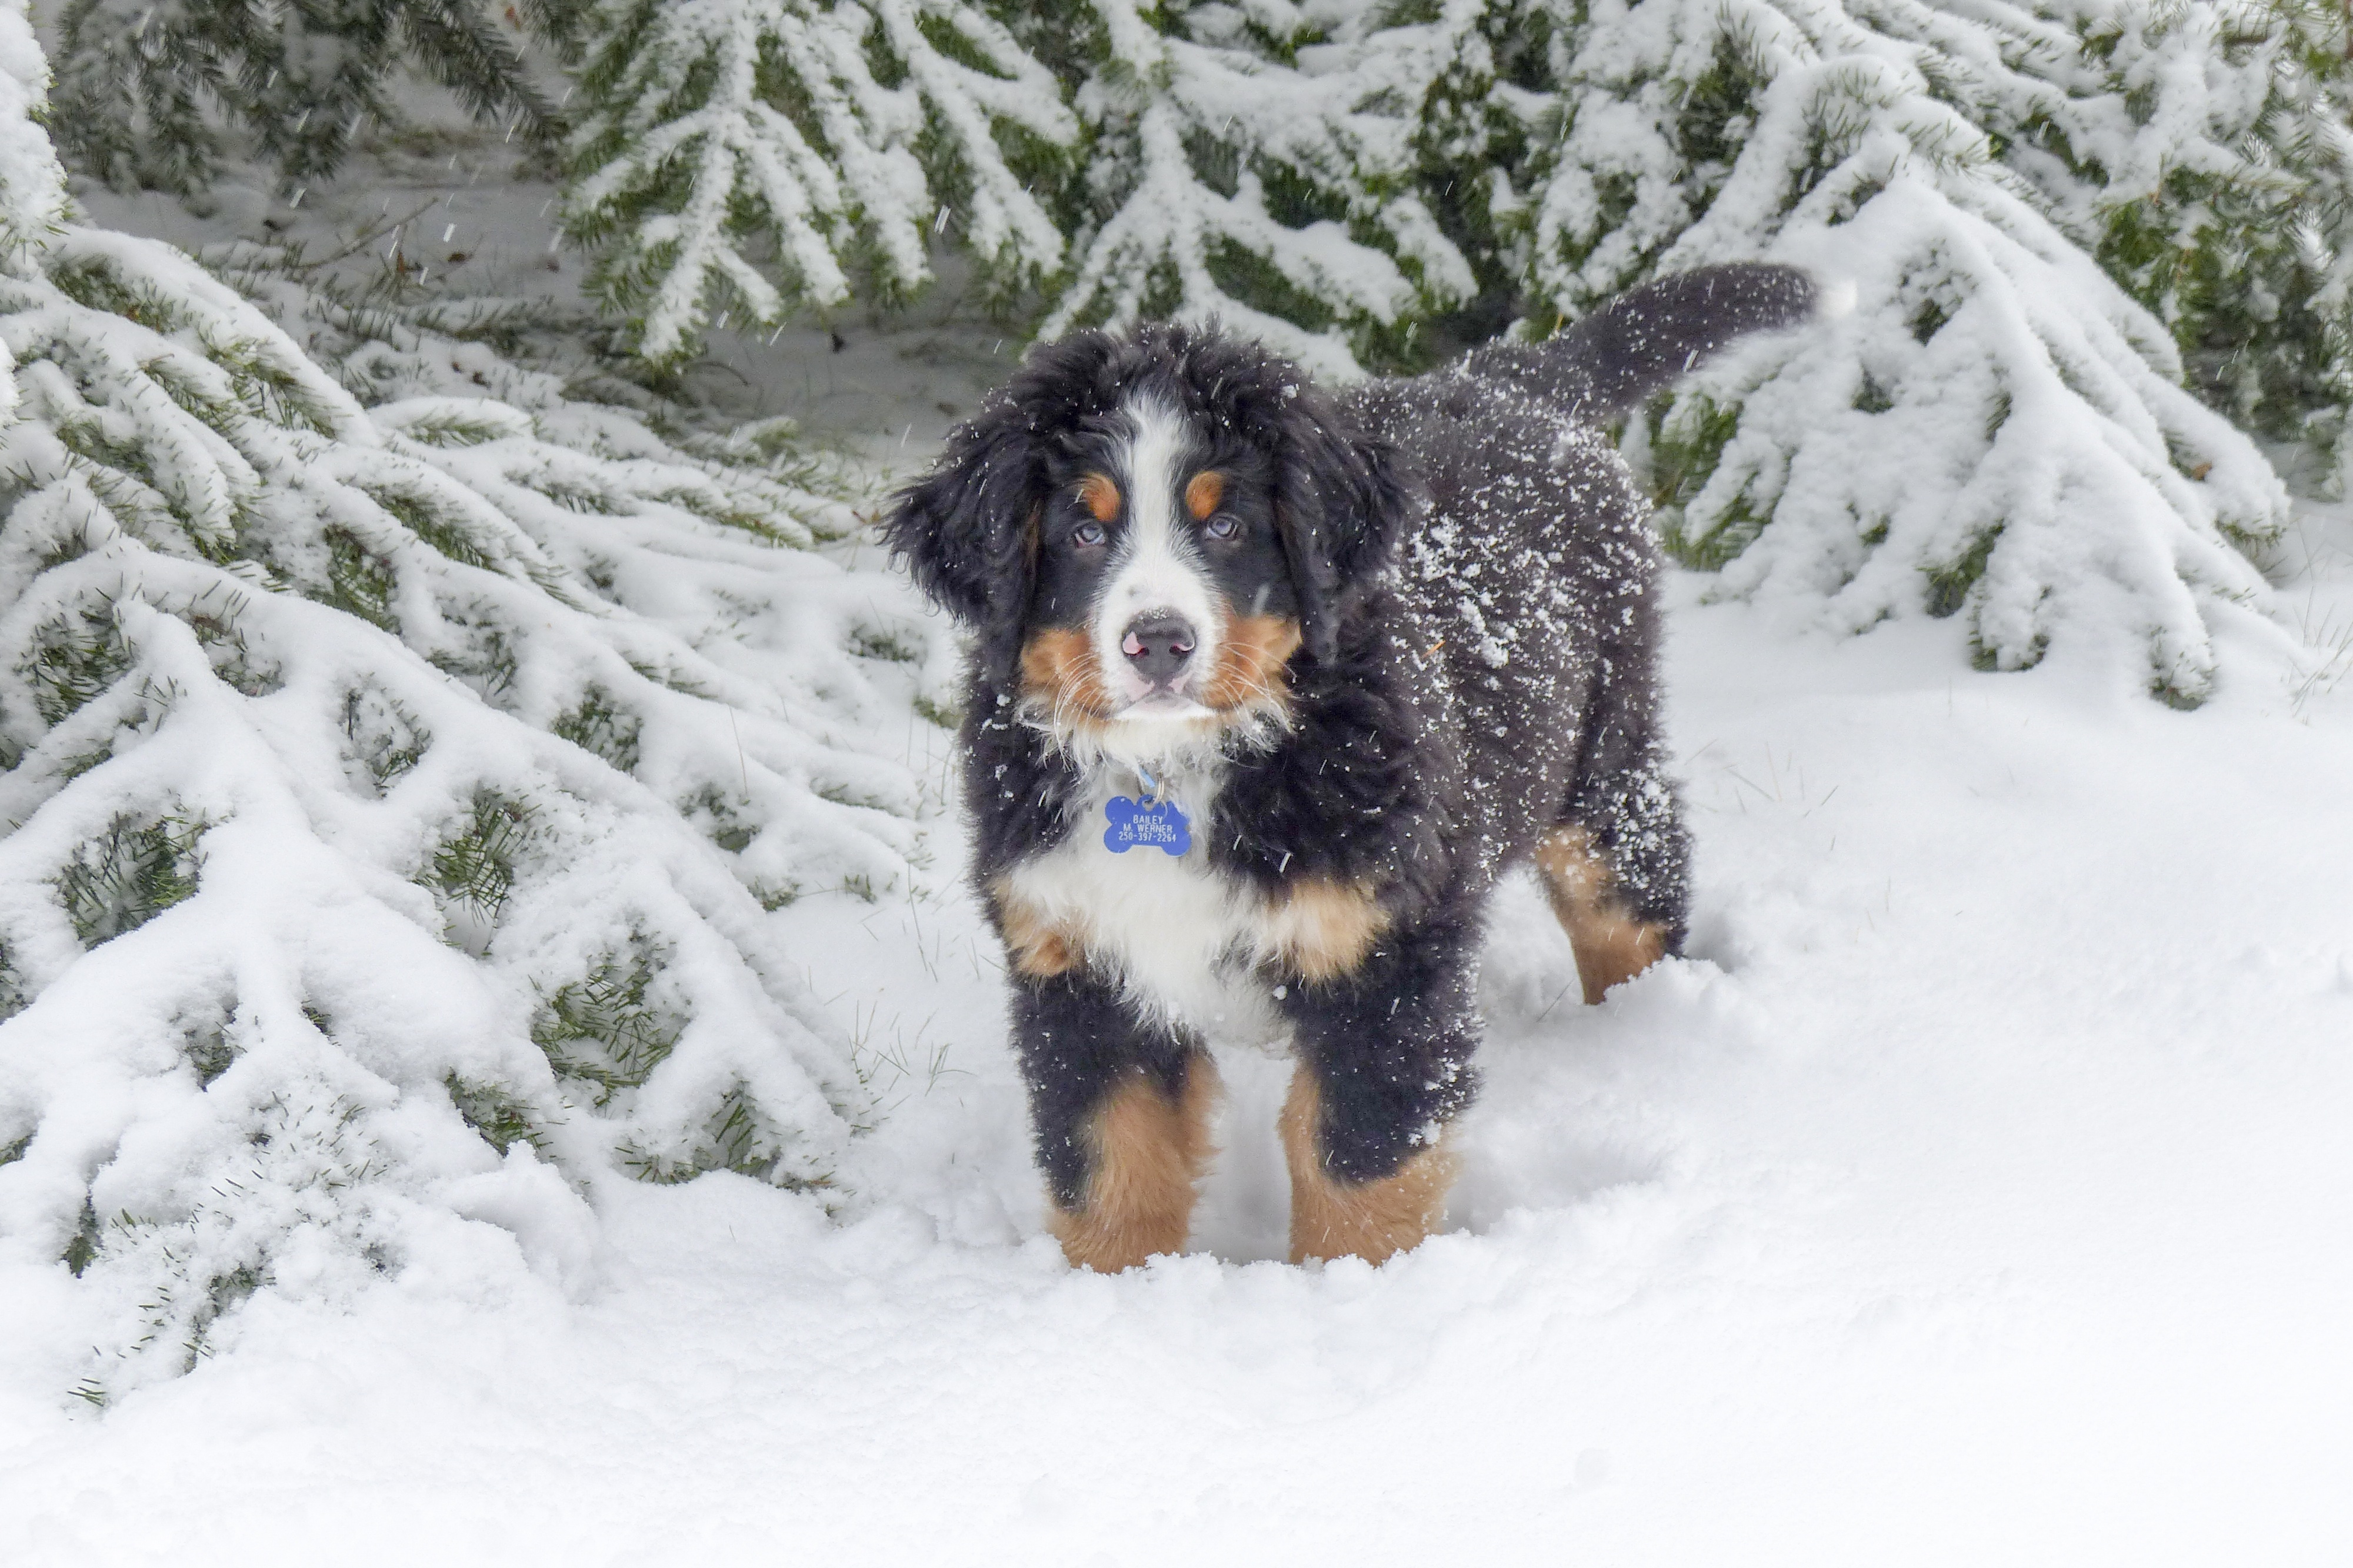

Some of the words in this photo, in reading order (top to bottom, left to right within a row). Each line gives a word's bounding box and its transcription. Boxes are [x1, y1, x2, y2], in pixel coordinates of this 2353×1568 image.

[1133, 815, 1163, 824] BAILEY
[1123, 823, 1133, 832] M.
[1138, 824, 1172, 833] WERNER
[1118, 831, 1176, 842] 250-397-2264
